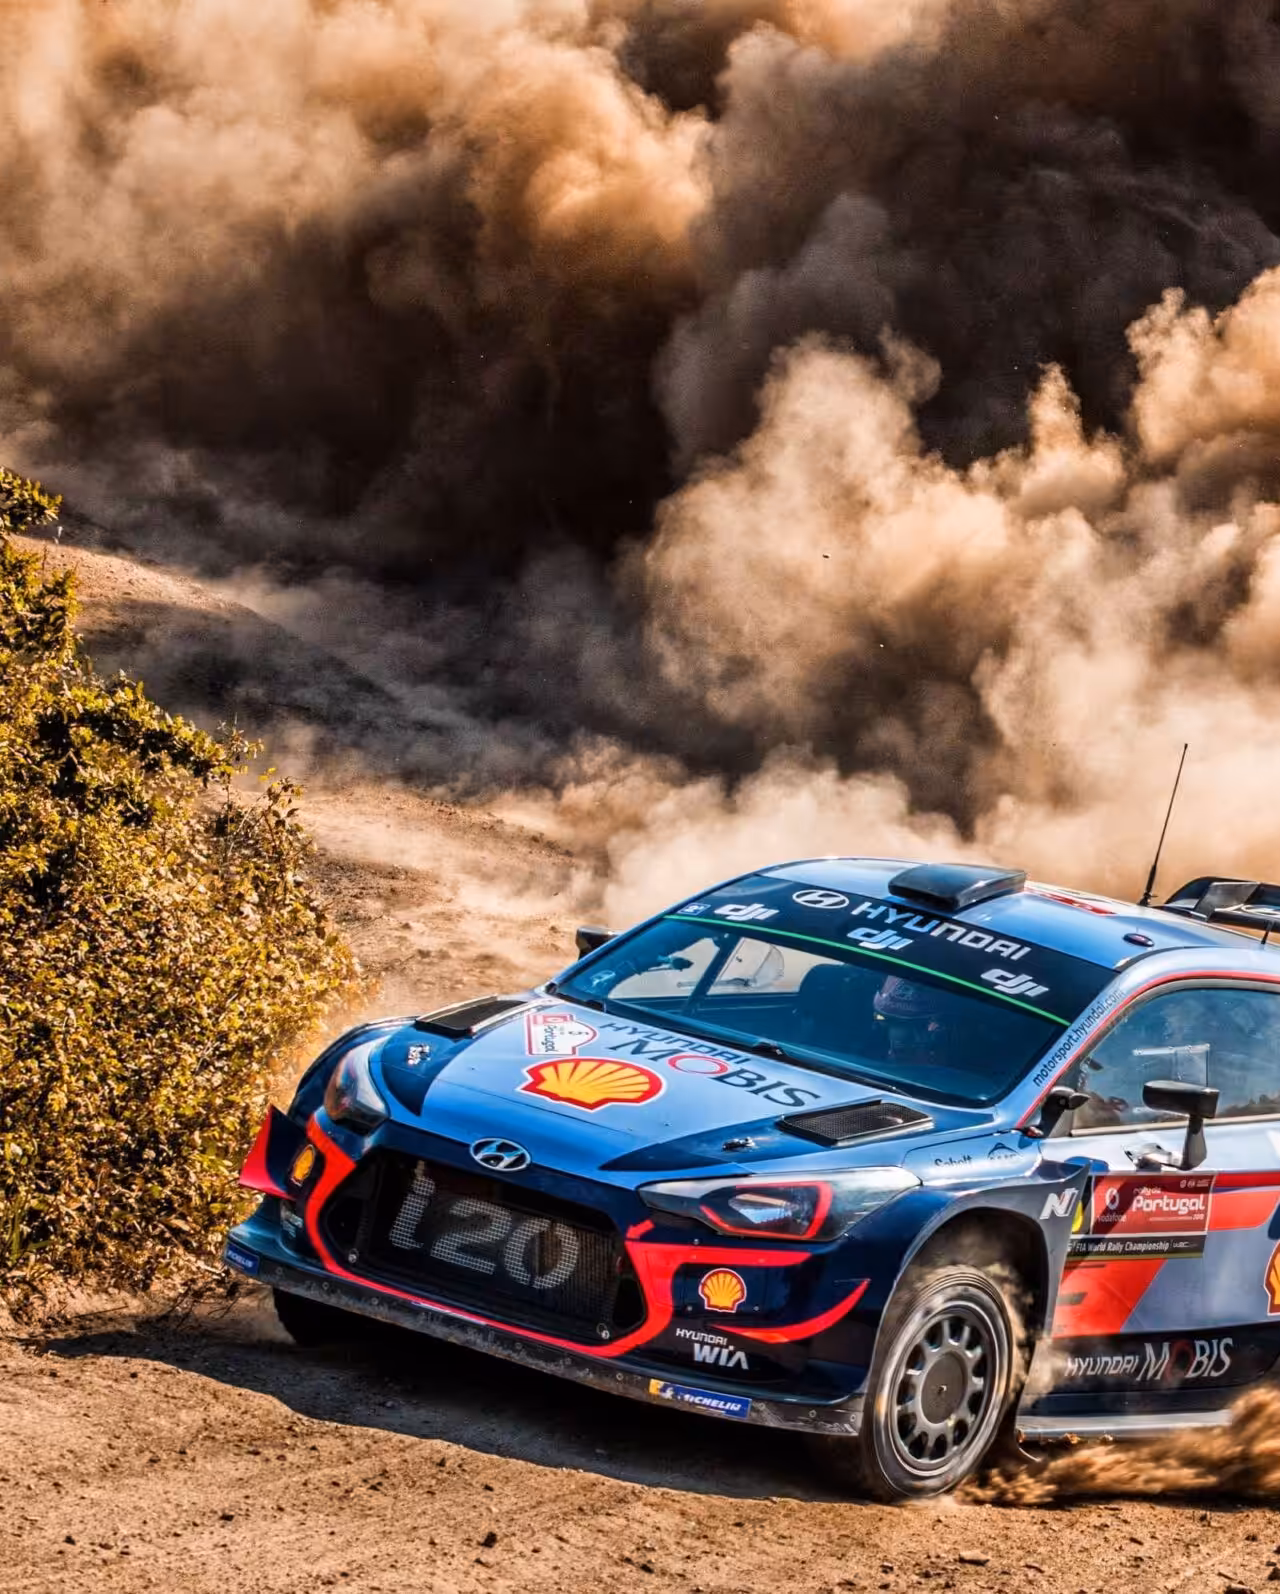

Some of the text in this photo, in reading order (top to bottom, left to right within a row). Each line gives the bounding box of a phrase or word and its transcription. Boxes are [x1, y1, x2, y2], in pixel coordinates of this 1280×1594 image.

[851, 901, 1031, 961] HYUNDAI
[601, 1022, 751, 1064] HYUNDAI
[1032, 989, 1116, 1087] motorsport.hyundai.com
[608, 1037, 821, 1107] MOBIS
[389, 1160, 579, 1289] i20
[1132, 1193, 1206, 1215] Portugal
[1106, 1241, 1123, 1254] Rally
[1125, 1240, 1170, 1253] Championship
[675, 1328, 728, 1346] HYUNDAI
[693, 1343, 749, 1370] WIA
[1063, 1337, 1234, 1382] HYUNDAI MOBIS
